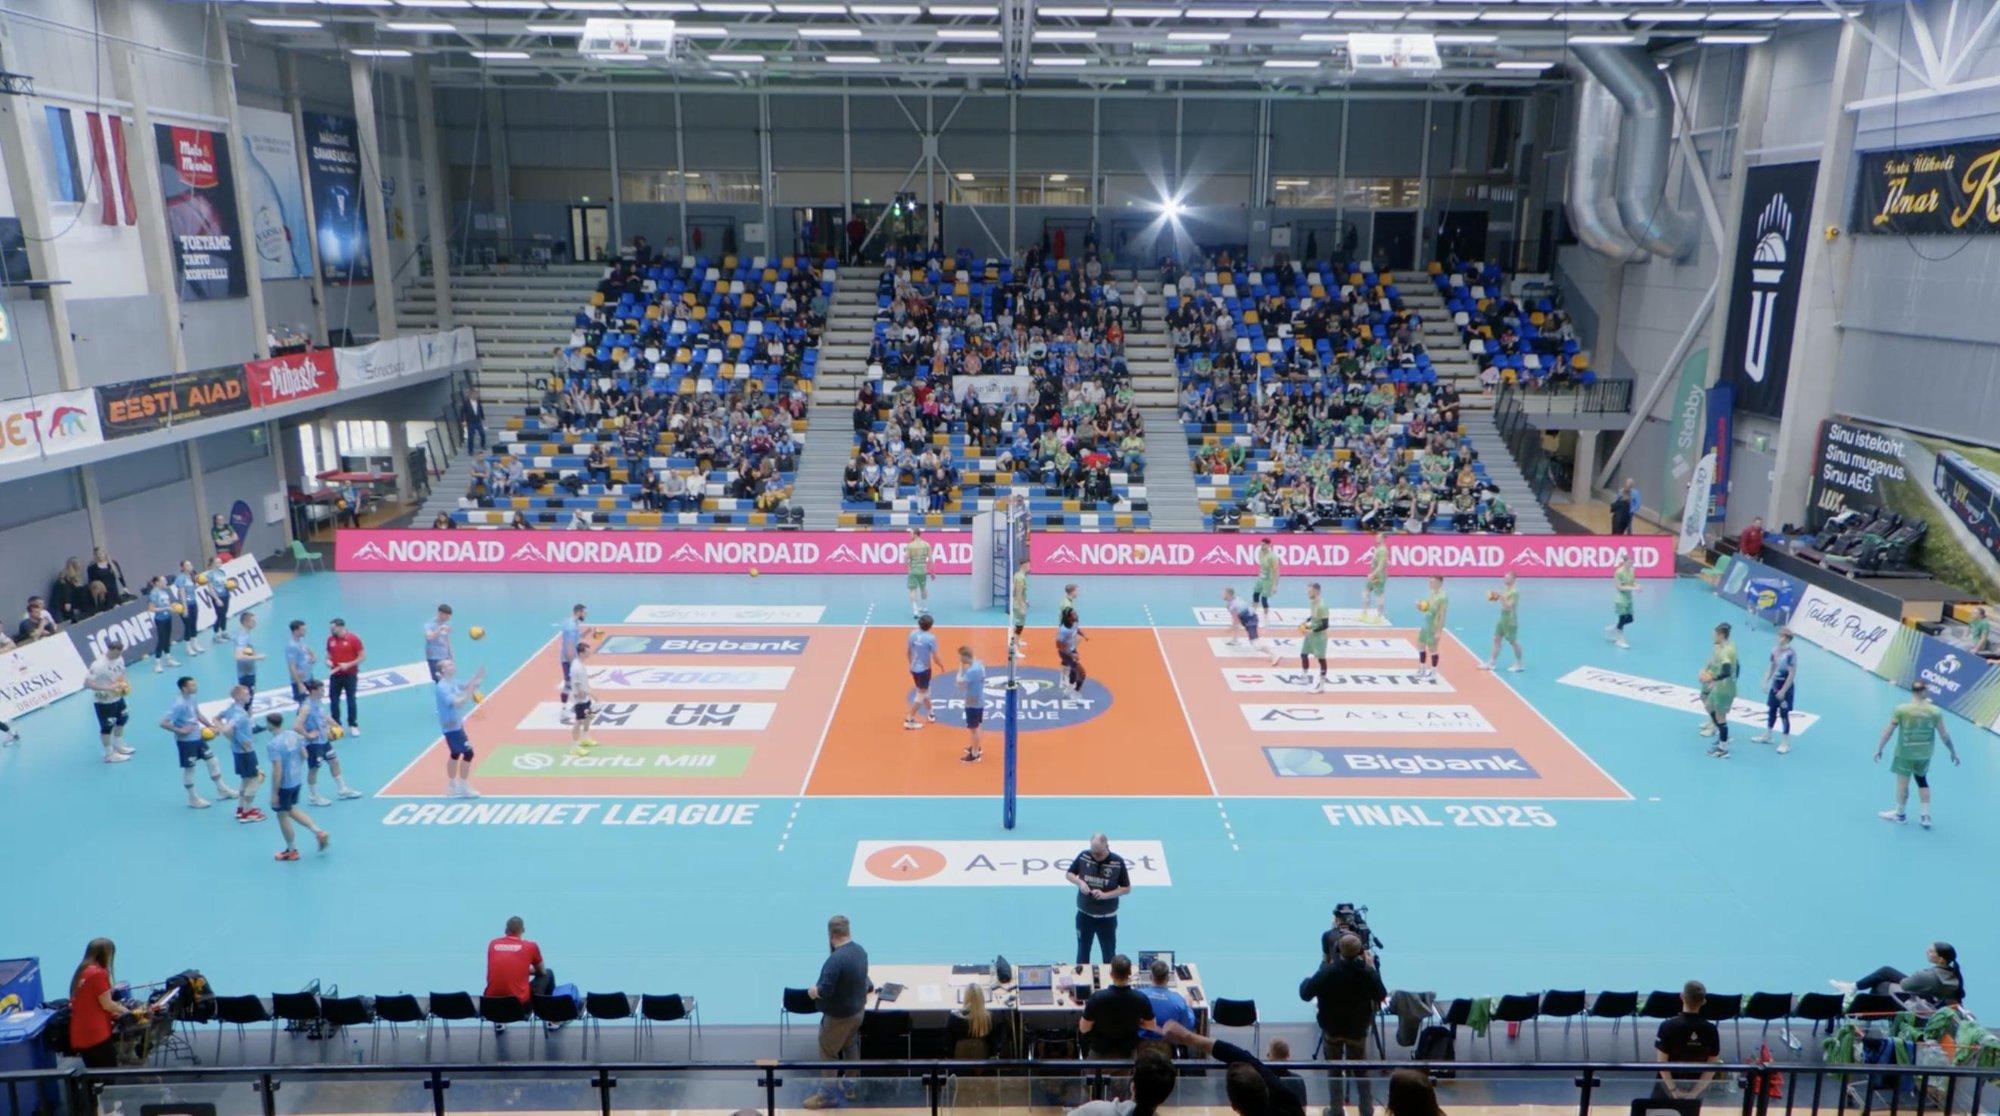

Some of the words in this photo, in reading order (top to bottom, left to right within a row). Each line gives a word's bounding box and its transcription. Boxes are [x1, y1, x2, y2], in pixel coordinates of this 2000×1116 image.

[1951, 149, 2000, 228] K
[1872, 176, 1939, 226] Ilmar
[179, 235, 232, 250] TOETAME
[182, 254, 210, 266] TARTU
[108, 391, 178, 424] EESTI
[188, 379, 241, 408] AIAD
[1678, 383, 1706, 450] Stebby
[1828, 424, 1855, 444] Sinu
[1855, 430, 1906, 458] istekoht.
[1825, 444, 1851, 465] Sinu
[1851, 454, 1907, 481] mugavus.
[1823, 463, 1848, 485] Sinu
[1847, 471, 1874, 494] AEG.
[388, 540, 505, 563] NORDAID
[546, 540, 663, 563] NORDAID
[704, 542, 820, 564] NORDAID
[861, 542, 973, 564] NOAID
[1081, 543, 1195, 565] NORDAID
[1236, 544, 1350, 566] NRDAID
[1390, 546, 1504, 568] NORDAID
[1545, 546, 1660, 568] NORDAID
[197, 566, 265, 610] WRTH
[660, 639, 800, 652] Bigbank
[931, 698, 1096, 710] CRIMET
[1344, 710, 1472, 720] ASCAR
[560, 754, 647, 768] Tartu
[654, 754, 718, 767] Mill
[1343, 754, 1528, 774] Bigbank
[382, 803, 601, 826] CRONIMET
[601, 803, 760, 826] LEAGUE
[1322, 804, 1444, 827] FINAL
[1444, 804, 1558, 828] 2025
